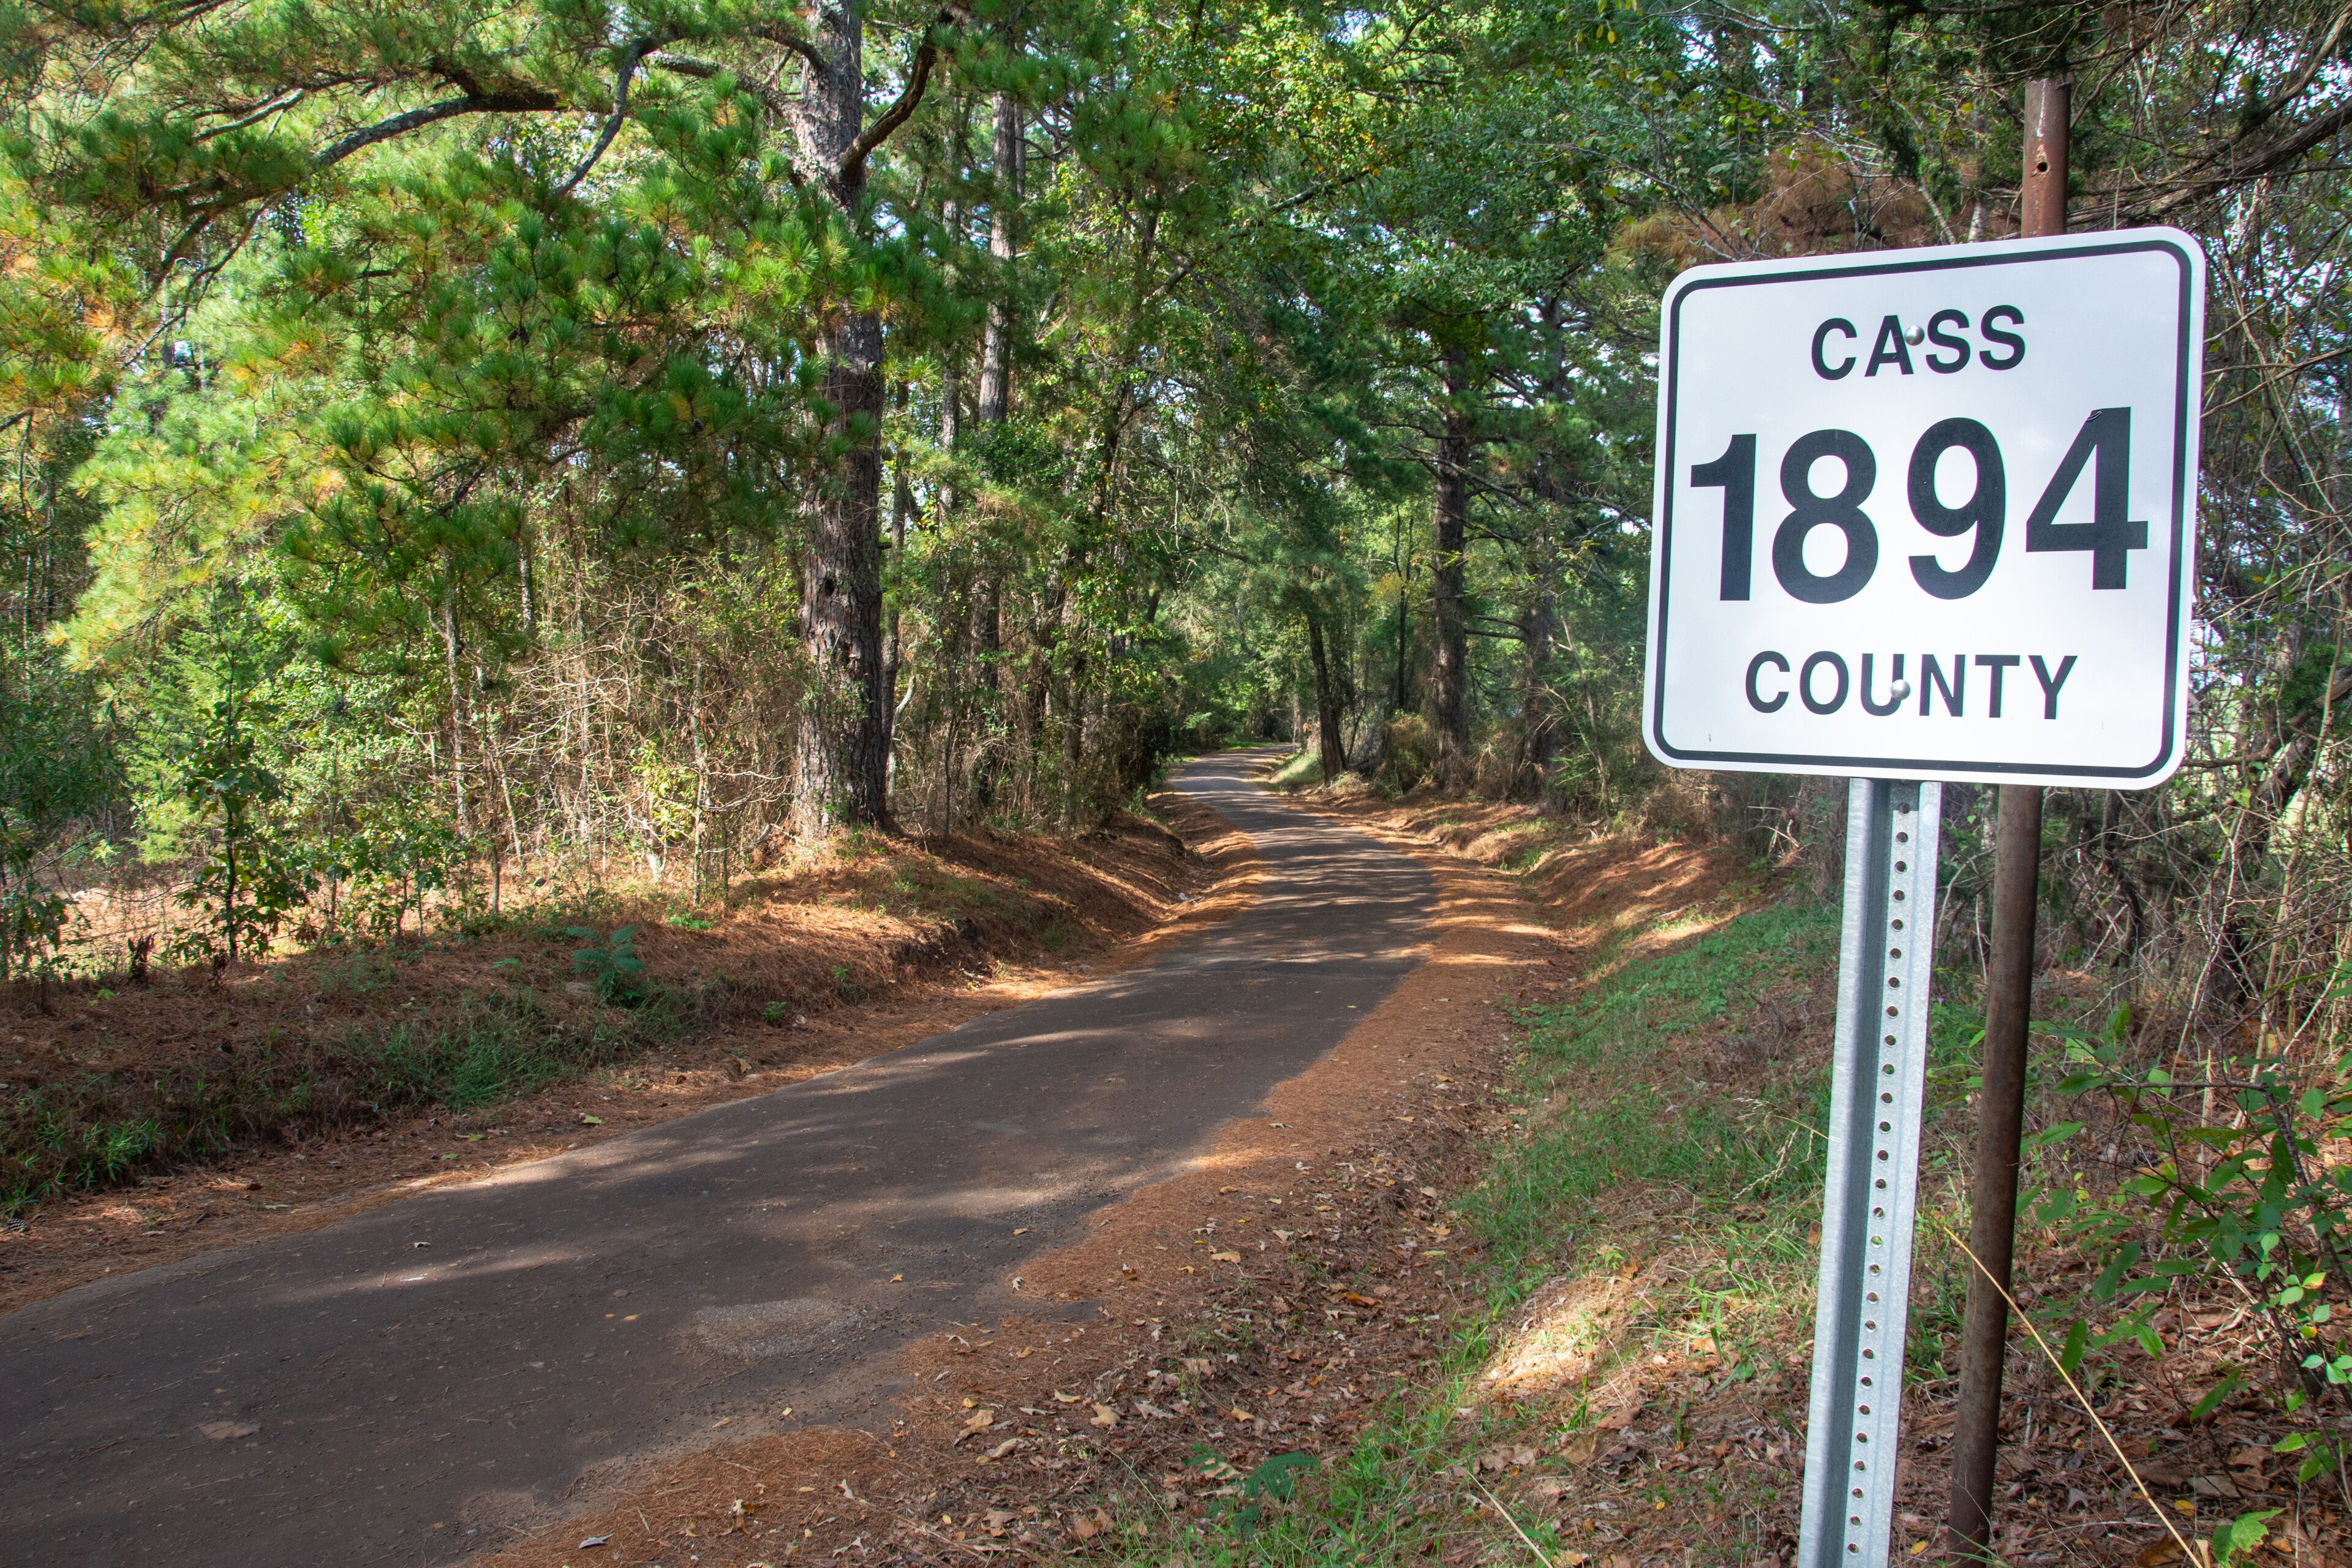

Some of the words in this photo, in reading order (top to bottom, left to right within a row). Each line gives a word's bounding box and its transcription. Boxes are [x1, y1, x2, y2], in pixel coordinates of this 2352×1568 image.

[1811, 304, 2026, 380] CASS
[1690, 406, 2148, 603] 1894
[1746, 650, 2078, 720] COUNTY
